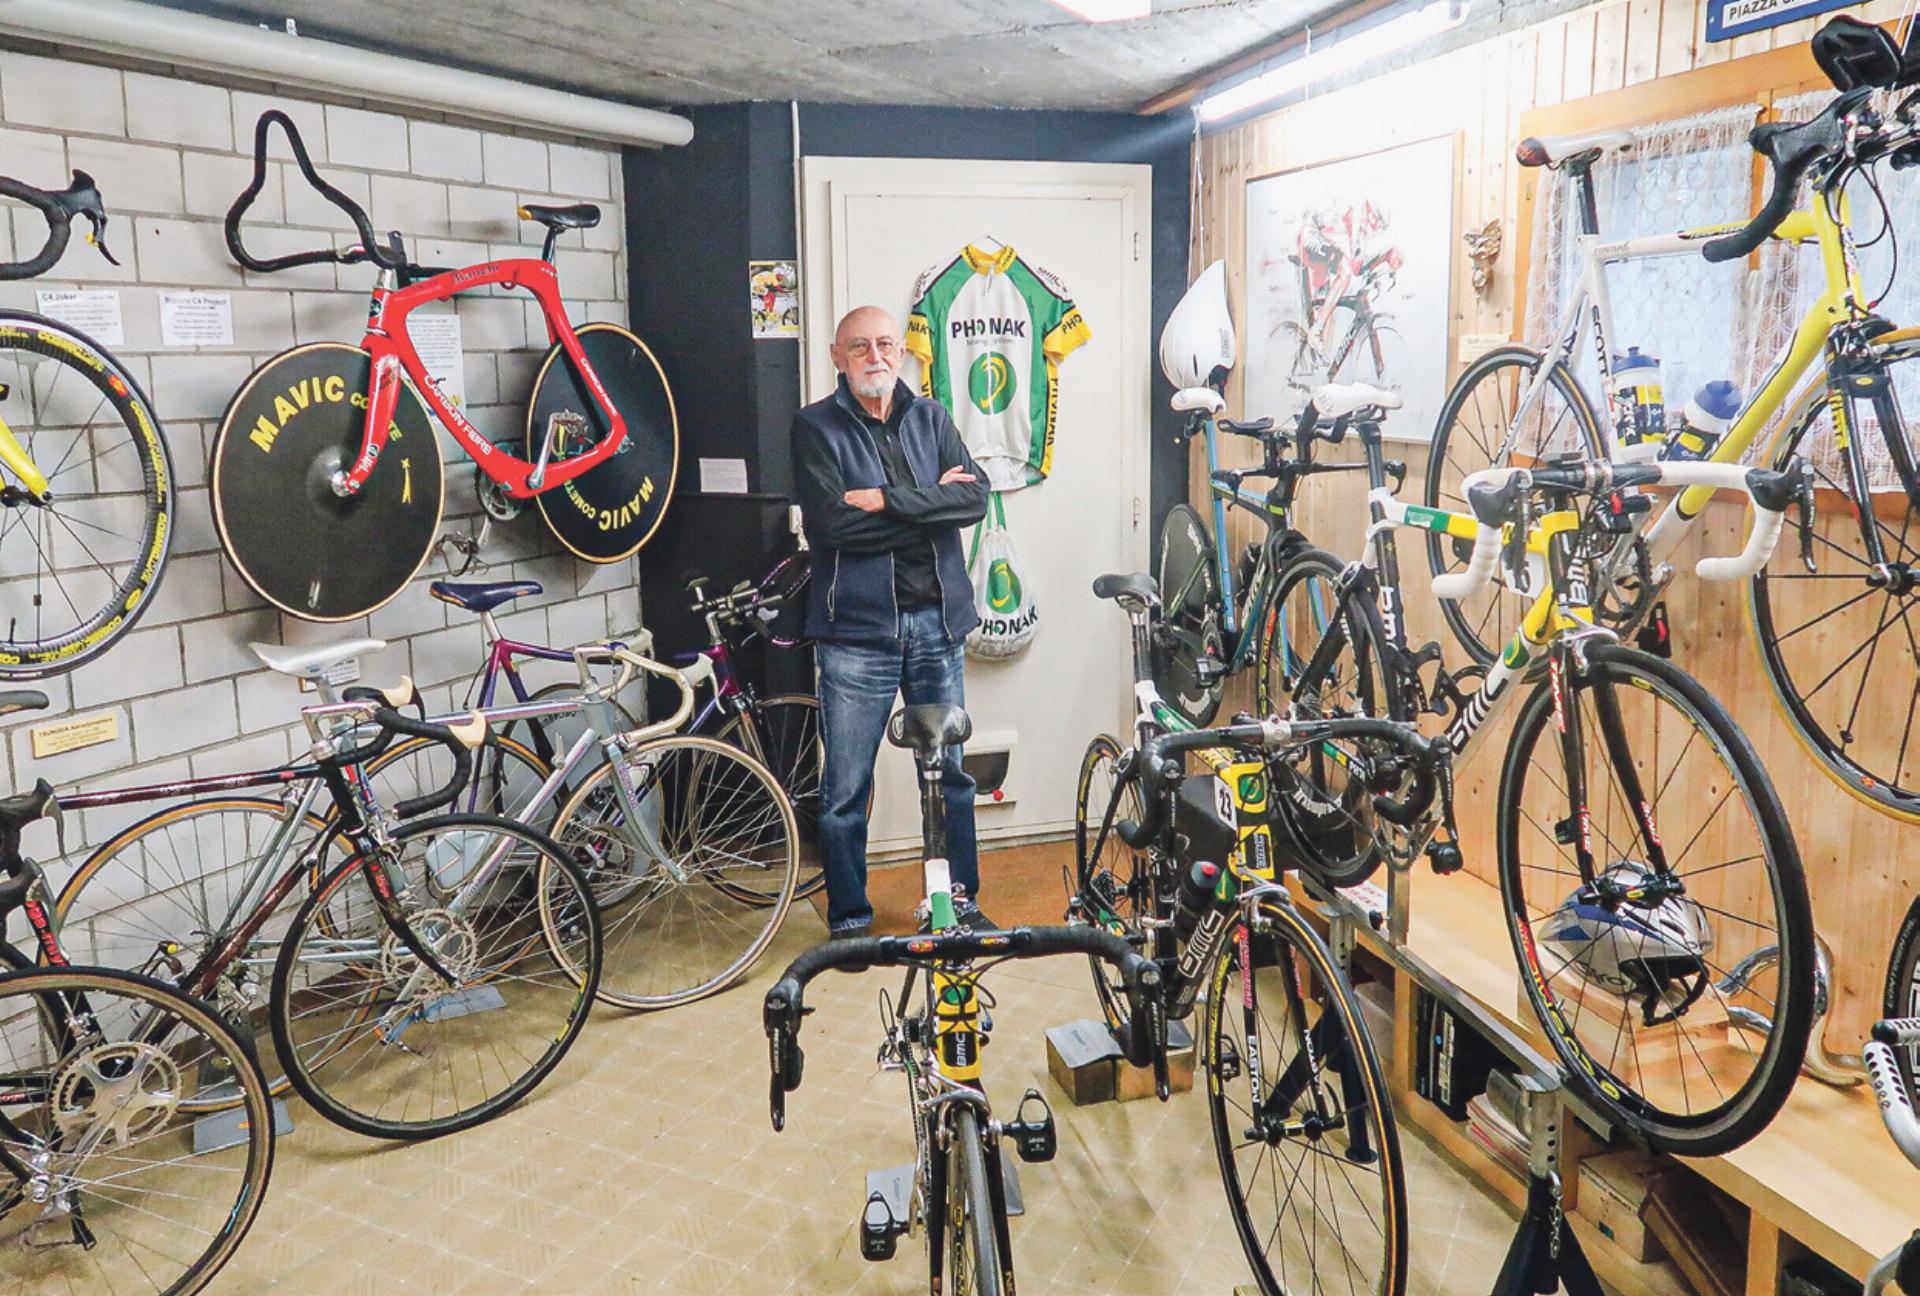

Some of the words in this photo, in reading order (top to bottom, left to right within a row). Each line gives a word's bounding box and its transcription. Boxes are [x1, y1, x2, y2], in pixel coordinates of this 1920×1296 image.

[1729, 0, 1778, 20] PIAZZA
[951, 317, 1026, 339] PHONAK
[1592, 305, 1609, 377] SCOTT
[249, 375, 345, 454] MAVIC
[598, 475, 656, 531] MAVIC
[1219, 788, 1233, 822] 23
[1247, 1034, 1260, 1104] EASTON
